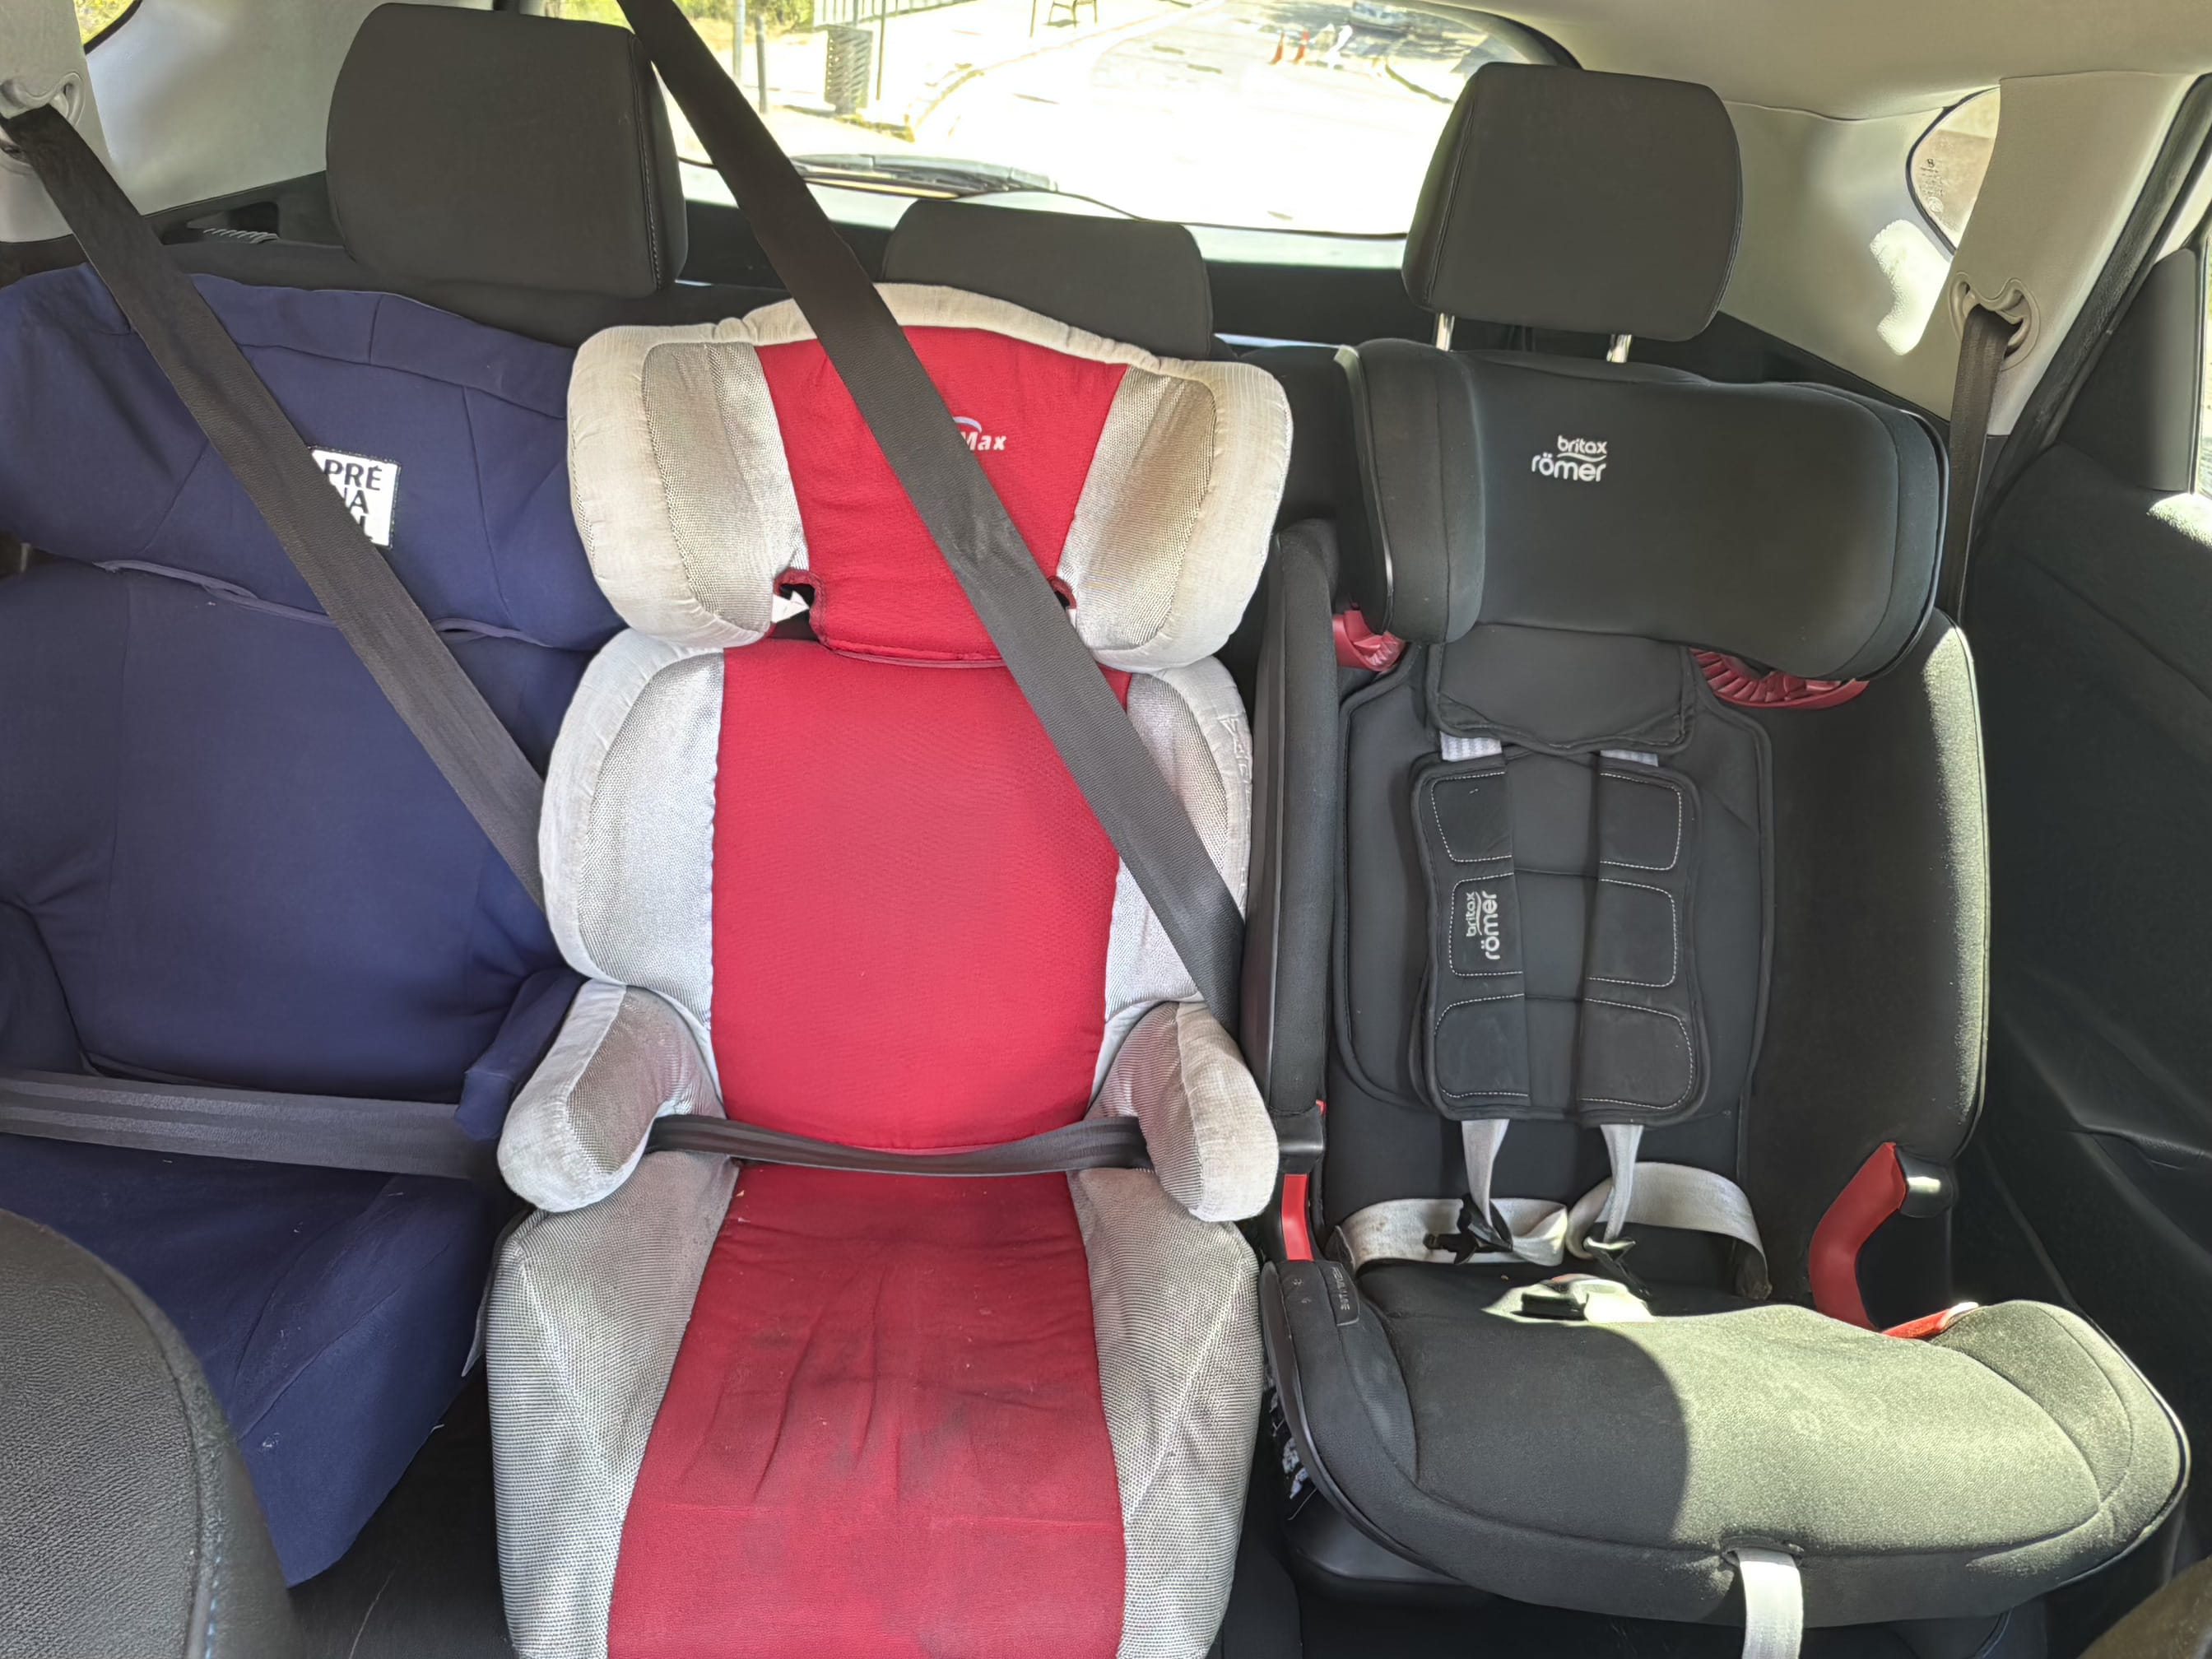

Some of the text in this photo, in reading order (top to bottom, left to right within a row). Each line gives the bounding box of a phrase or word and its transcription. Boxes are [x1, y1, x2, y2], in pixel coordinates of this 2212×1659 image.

[1557, 434, 1608, 454] britax
[1531, 452, 1607, 482] römer
[1465, 891, 1477, 937] britax
[1480, 890, 1501, 960] römer
